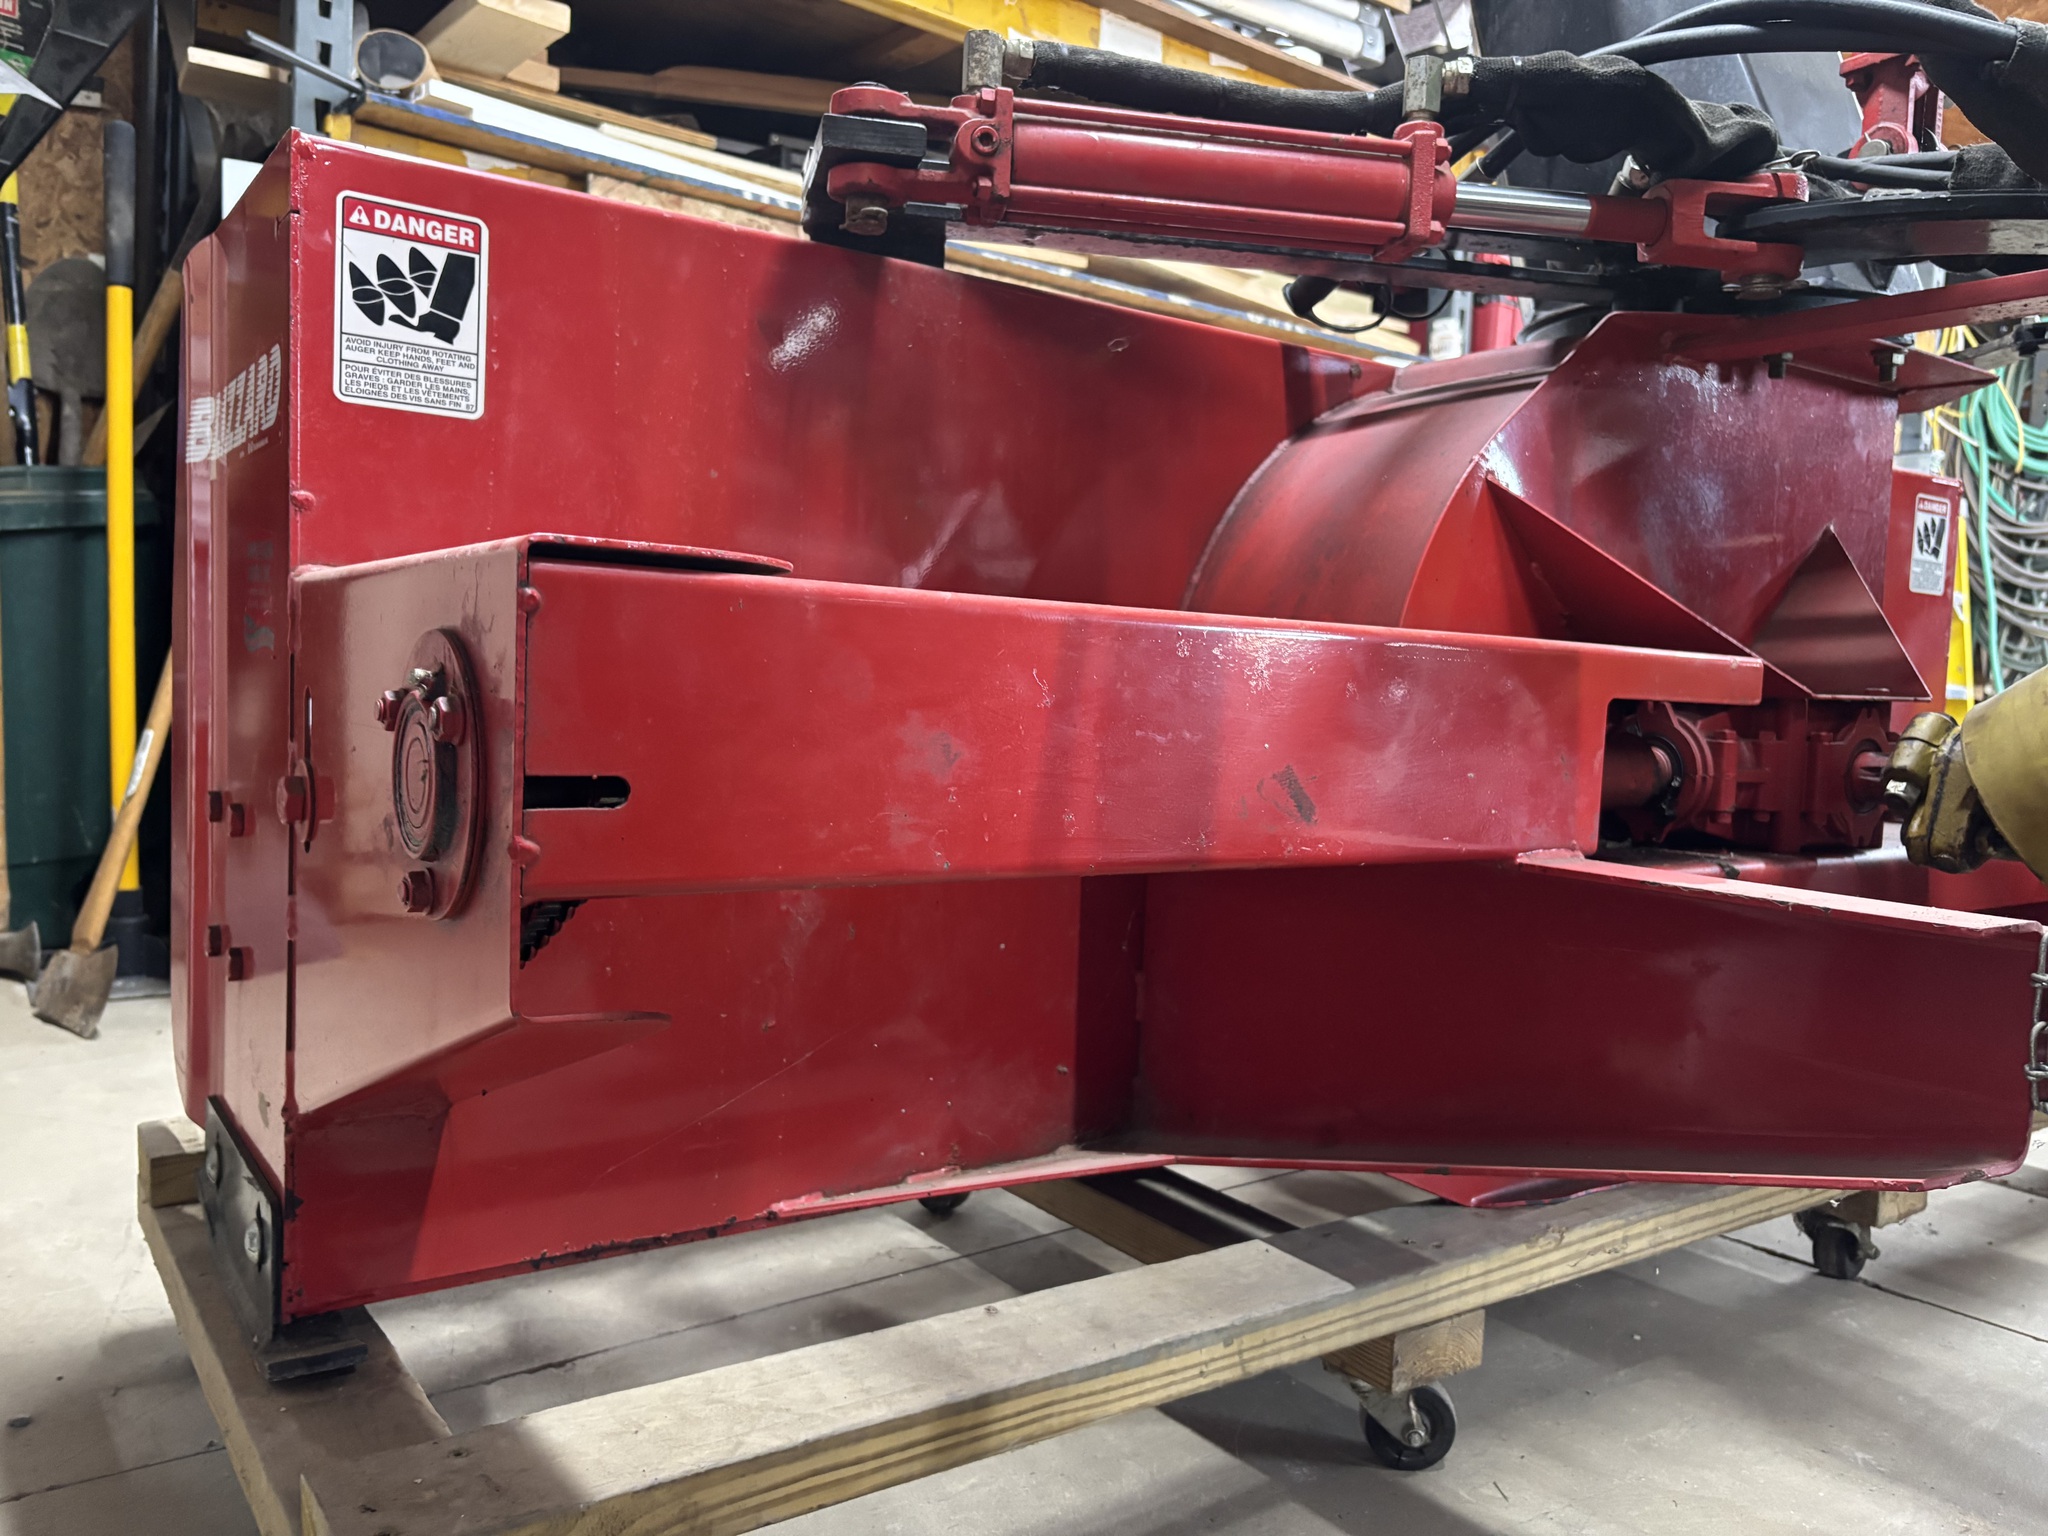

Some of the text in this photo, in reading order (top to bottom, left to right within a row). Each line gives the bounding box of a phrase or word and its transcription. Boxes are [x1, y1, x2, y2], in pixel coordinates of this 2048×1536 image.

[374, 208, 475, 247] DANGER
[345, 337, 472, 362] AVOID INJURY FROM ROTATING
[345, 344, 475, 370] AUGER KEEP HANDS, FEET AND
[345, 364, 472, 388] POUR ÉVITER DES BLESSURES
[376, 356, 444, 372] CLOTHING AWAY
[345, 372, 380, 382] GRAVES
[387, 378, 422, 389] GARDER
[425, 383, 440, 391] LES
[443, 386, 470, 396] MAINS,
[364, 382, 389, 391] PIEDS
[391, 385, 402, 393] ET
[404, 387, 419, 395] LES
[422, 389, 470, 402] VÊTEMENTS
[391, 392, 407, 400] DES
[424, 397, 446, 406] SANS
[449, 400, 461, 408] FIN
[1924, 501, 1947, 513] DANGER
